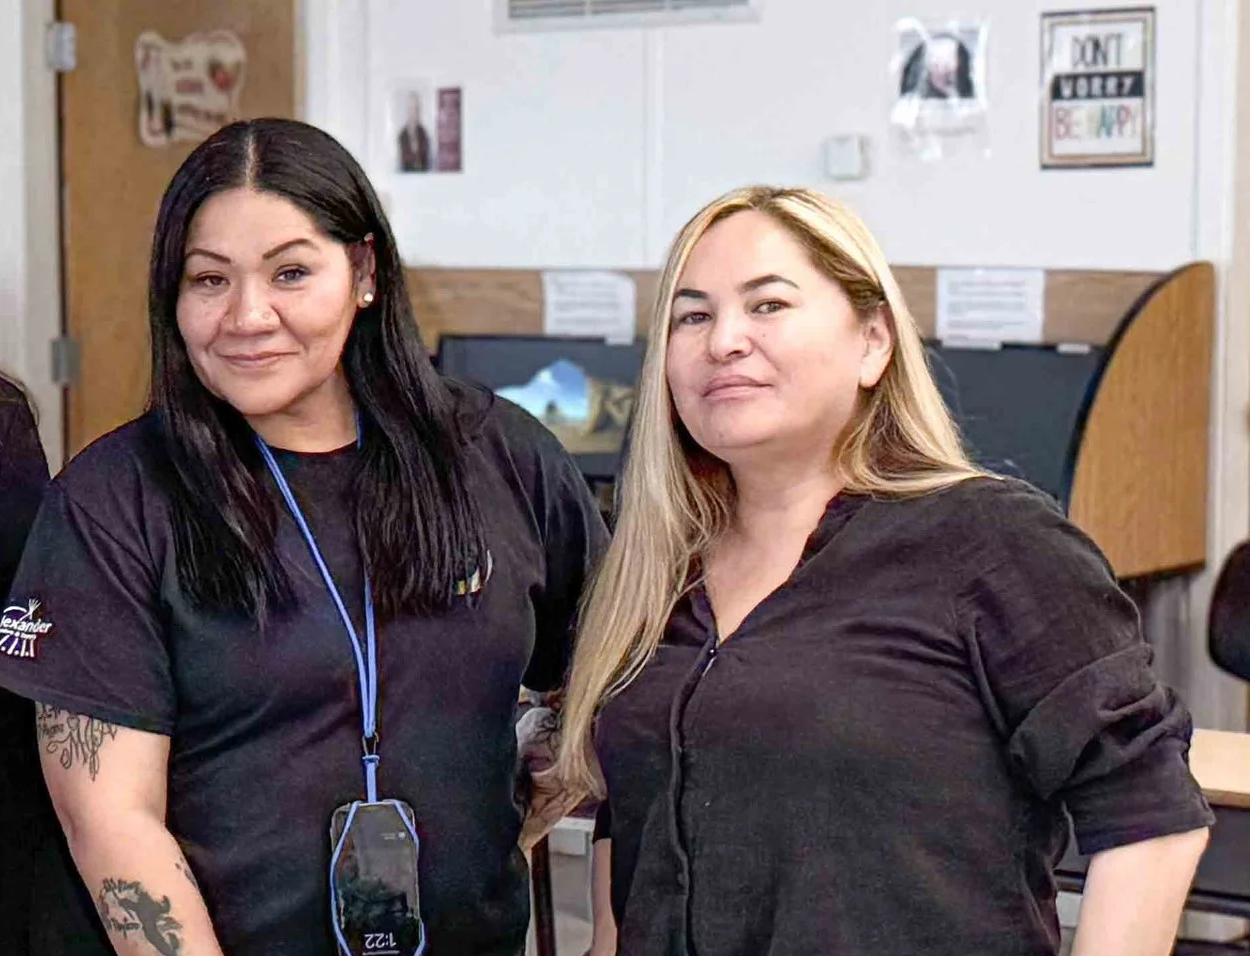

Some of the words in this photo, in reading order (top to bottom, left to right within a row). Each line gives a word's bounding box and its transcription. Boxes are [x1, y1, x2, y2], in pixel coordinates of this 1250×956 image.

[1059, 76, 1134, 98] WORRY
[1055, 106, 1082, 140] BE
[0, 615, 52, 633] lexander
[363, 931, 397, 950] 1:22
